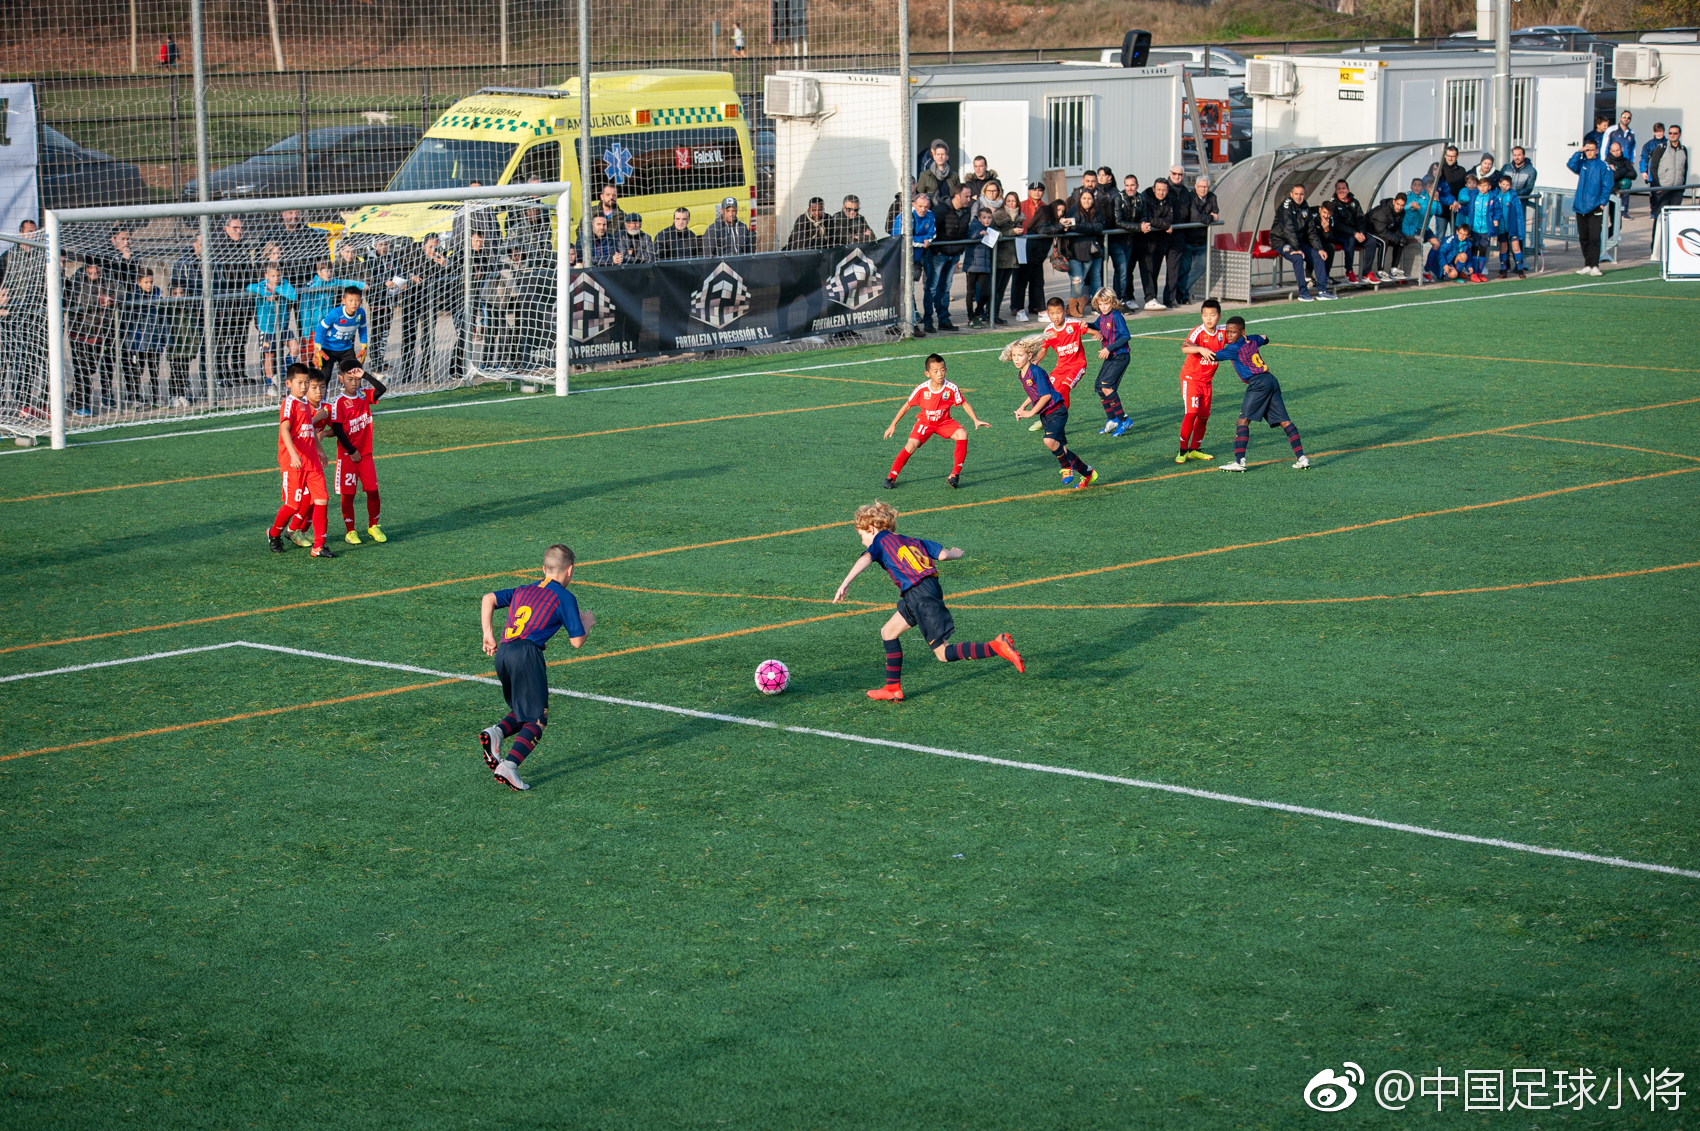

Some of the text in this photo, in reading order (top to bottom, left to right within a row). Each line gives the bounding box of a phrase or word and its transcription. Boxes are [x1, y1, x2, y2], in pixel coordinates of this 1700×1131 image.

[567, 113, 631, 131] AMULÀNCIA
[694, 150, 714, 164] Falck
[812, 306, 898, 331] FORTALEZA Y PRECISIÓN S.L.
[675, 326, 773, 349] FORTALEZA Y PRECISIÓN S.L.
[574, 345, 580, 359] Y
[580, 340, 621, 358] PRECISIÓN
[622, 340, 637, 354] S.L.
[1191, 396, 1200, 408] 13
[345, 472, 357, 486] 24
[295, 488, 302, 502] 6
[896, 545, 933, 574] 10
[504, 605, 532, 640] 3
